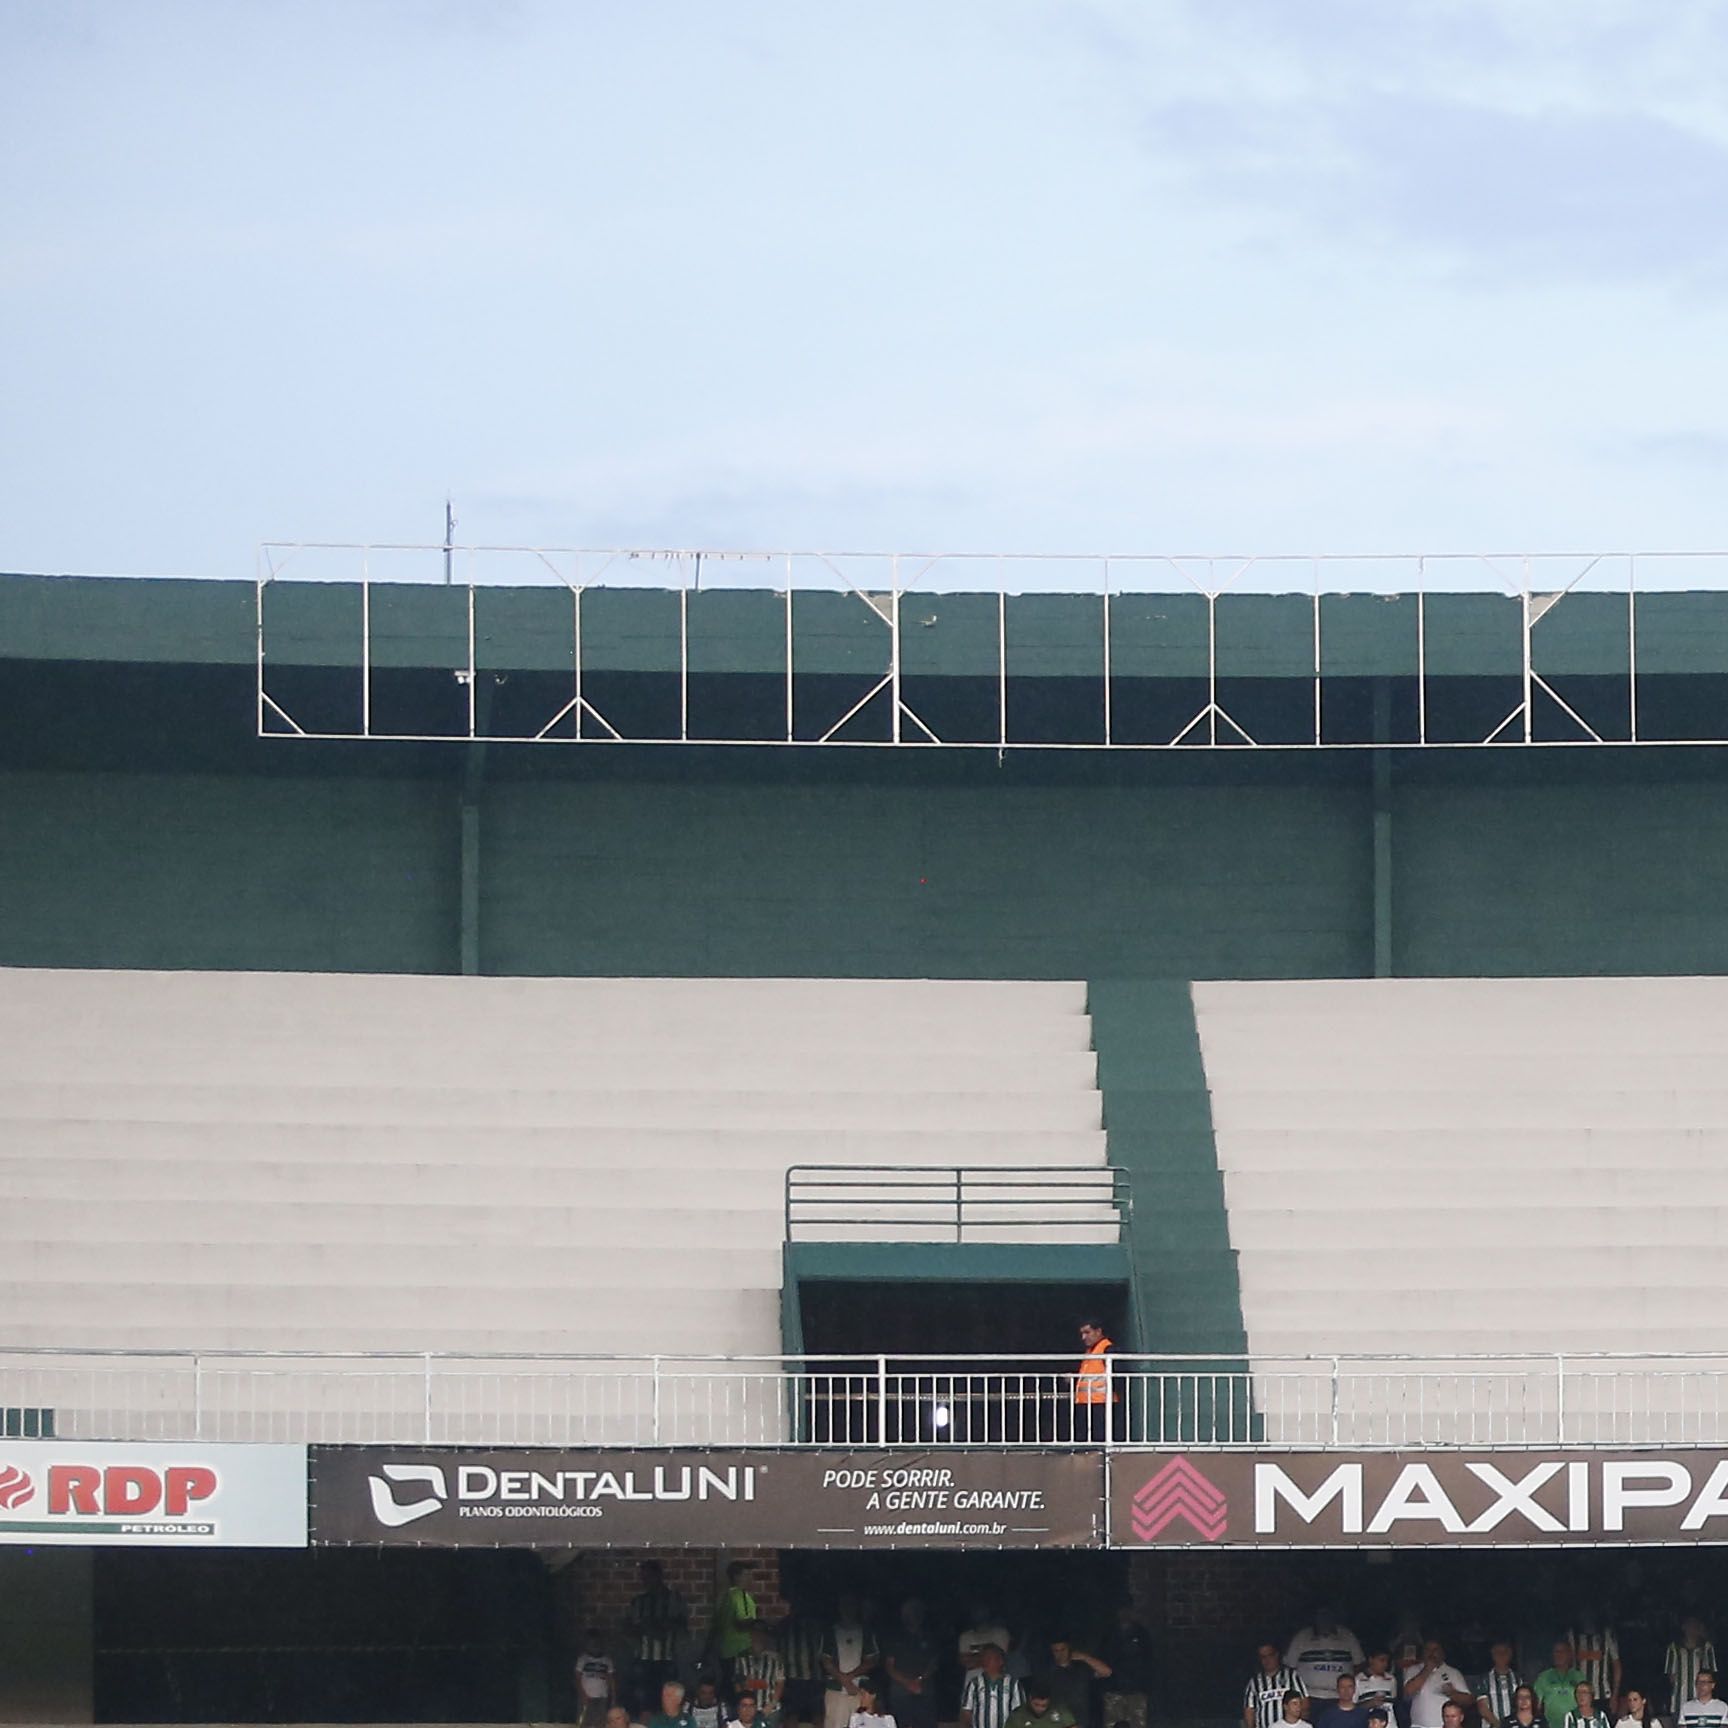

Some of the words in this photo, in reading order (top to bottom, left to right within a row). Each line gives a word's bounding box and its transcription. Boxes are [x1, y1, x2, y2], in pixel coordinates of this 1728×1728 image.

[822, 1470, 875, 1489] PODE
[879, 1470, 956, 1489] SORRIR.
[47, 1465, 216, 1515] RDP
[865, 1491, 879, 1510] A
[883, 1490, 951, 1510] GENTE
[954, 1490, 1046, 1510] GARANTE.
[459, 1506, 504, 1518] PLANOS
[506, 1505, 602, 1518] ODONTOLÓGICOS
[120, 1522, 212, 1535] PETRÓLEO
[863, 1520, 1006, 1537] www.dentaluni.com.br
